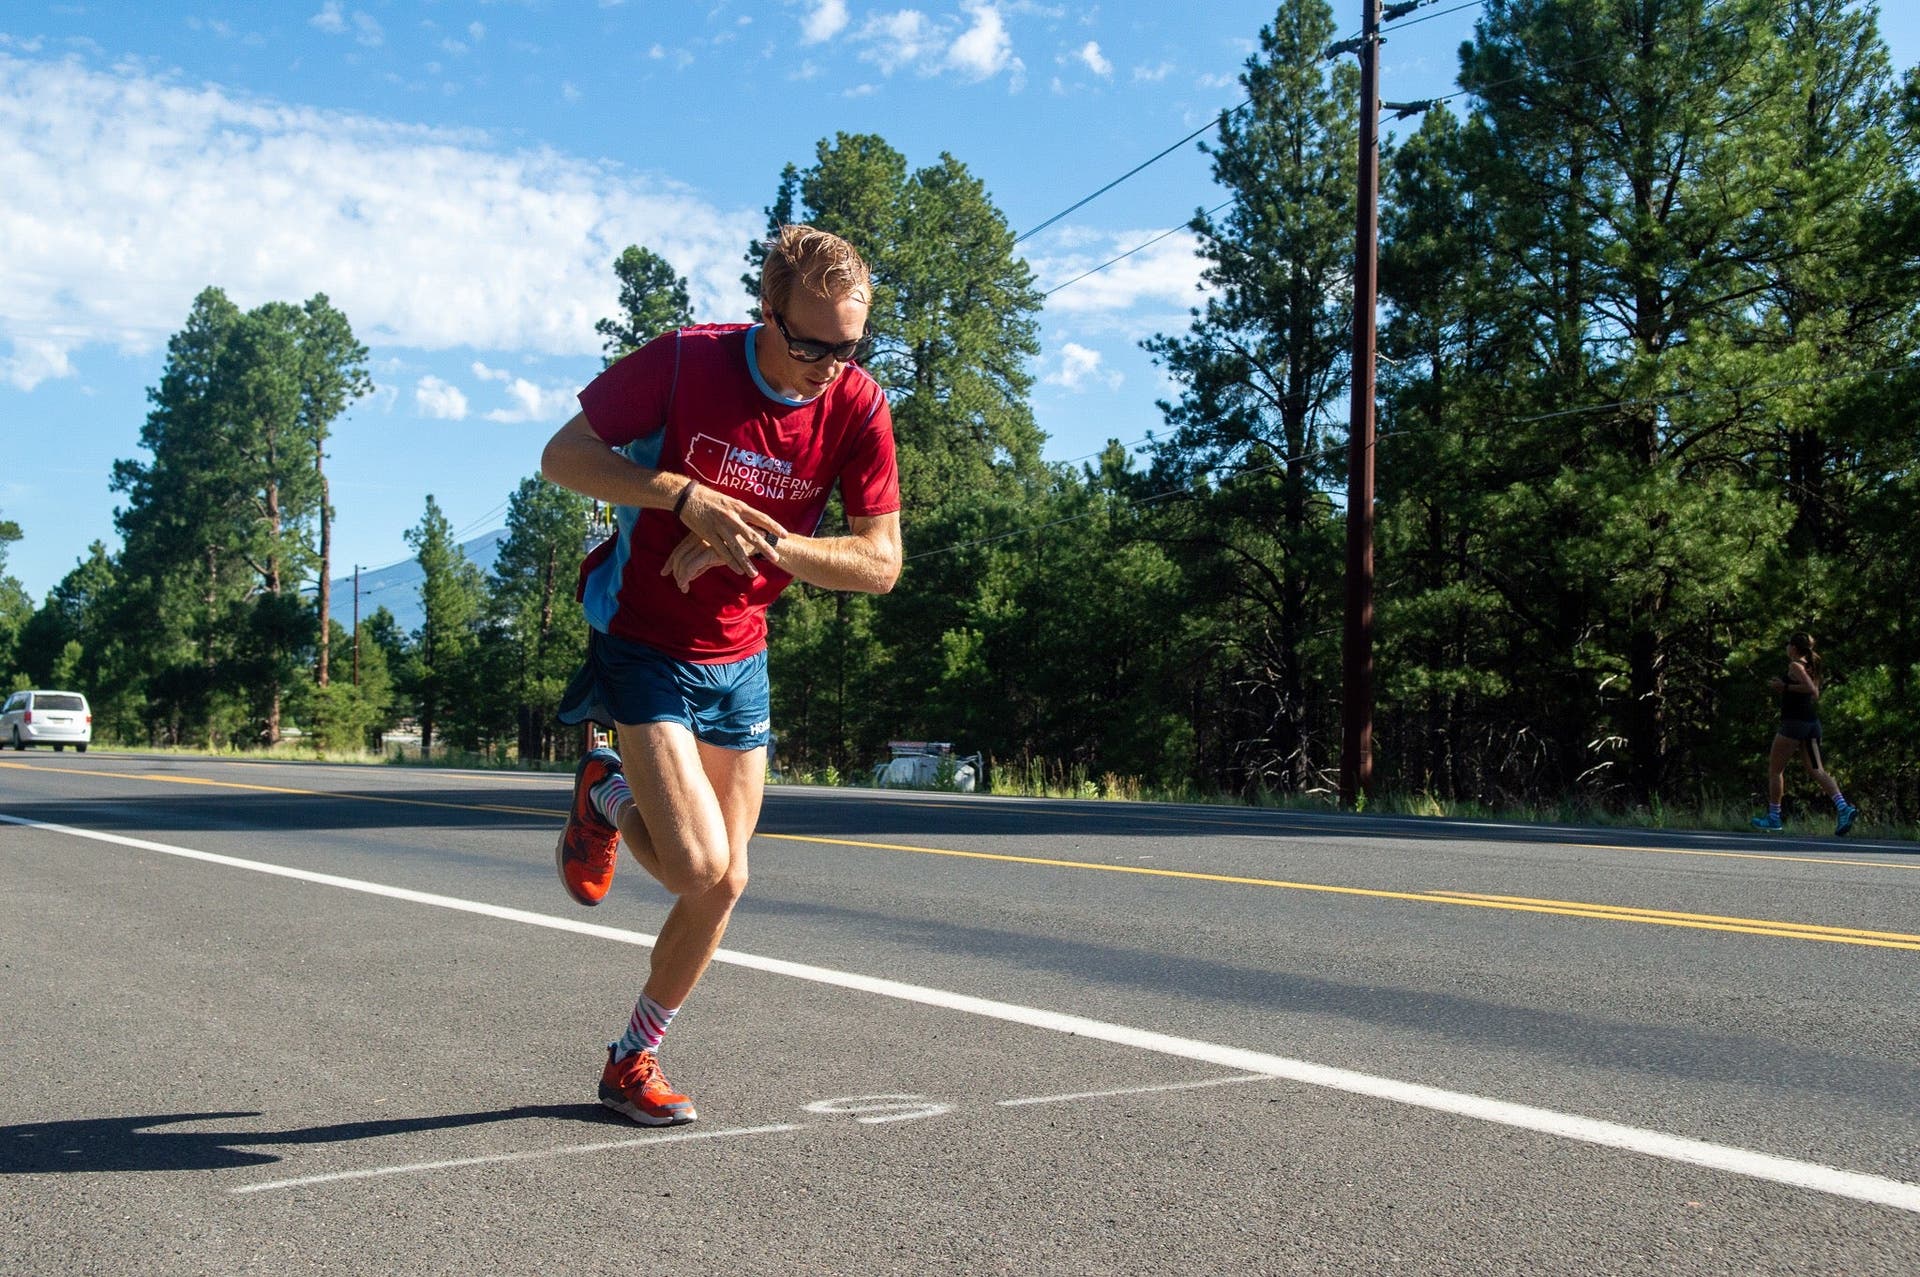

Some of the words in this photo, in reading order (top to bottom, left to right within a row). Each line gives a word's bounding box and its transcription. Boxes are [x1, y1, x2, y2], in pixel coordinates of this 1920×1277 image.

[728, 447, 774, 470] HOKA
[720, 475, 784, 499] ARIZONA
[725, 461, 812, 490] NORTHERN
